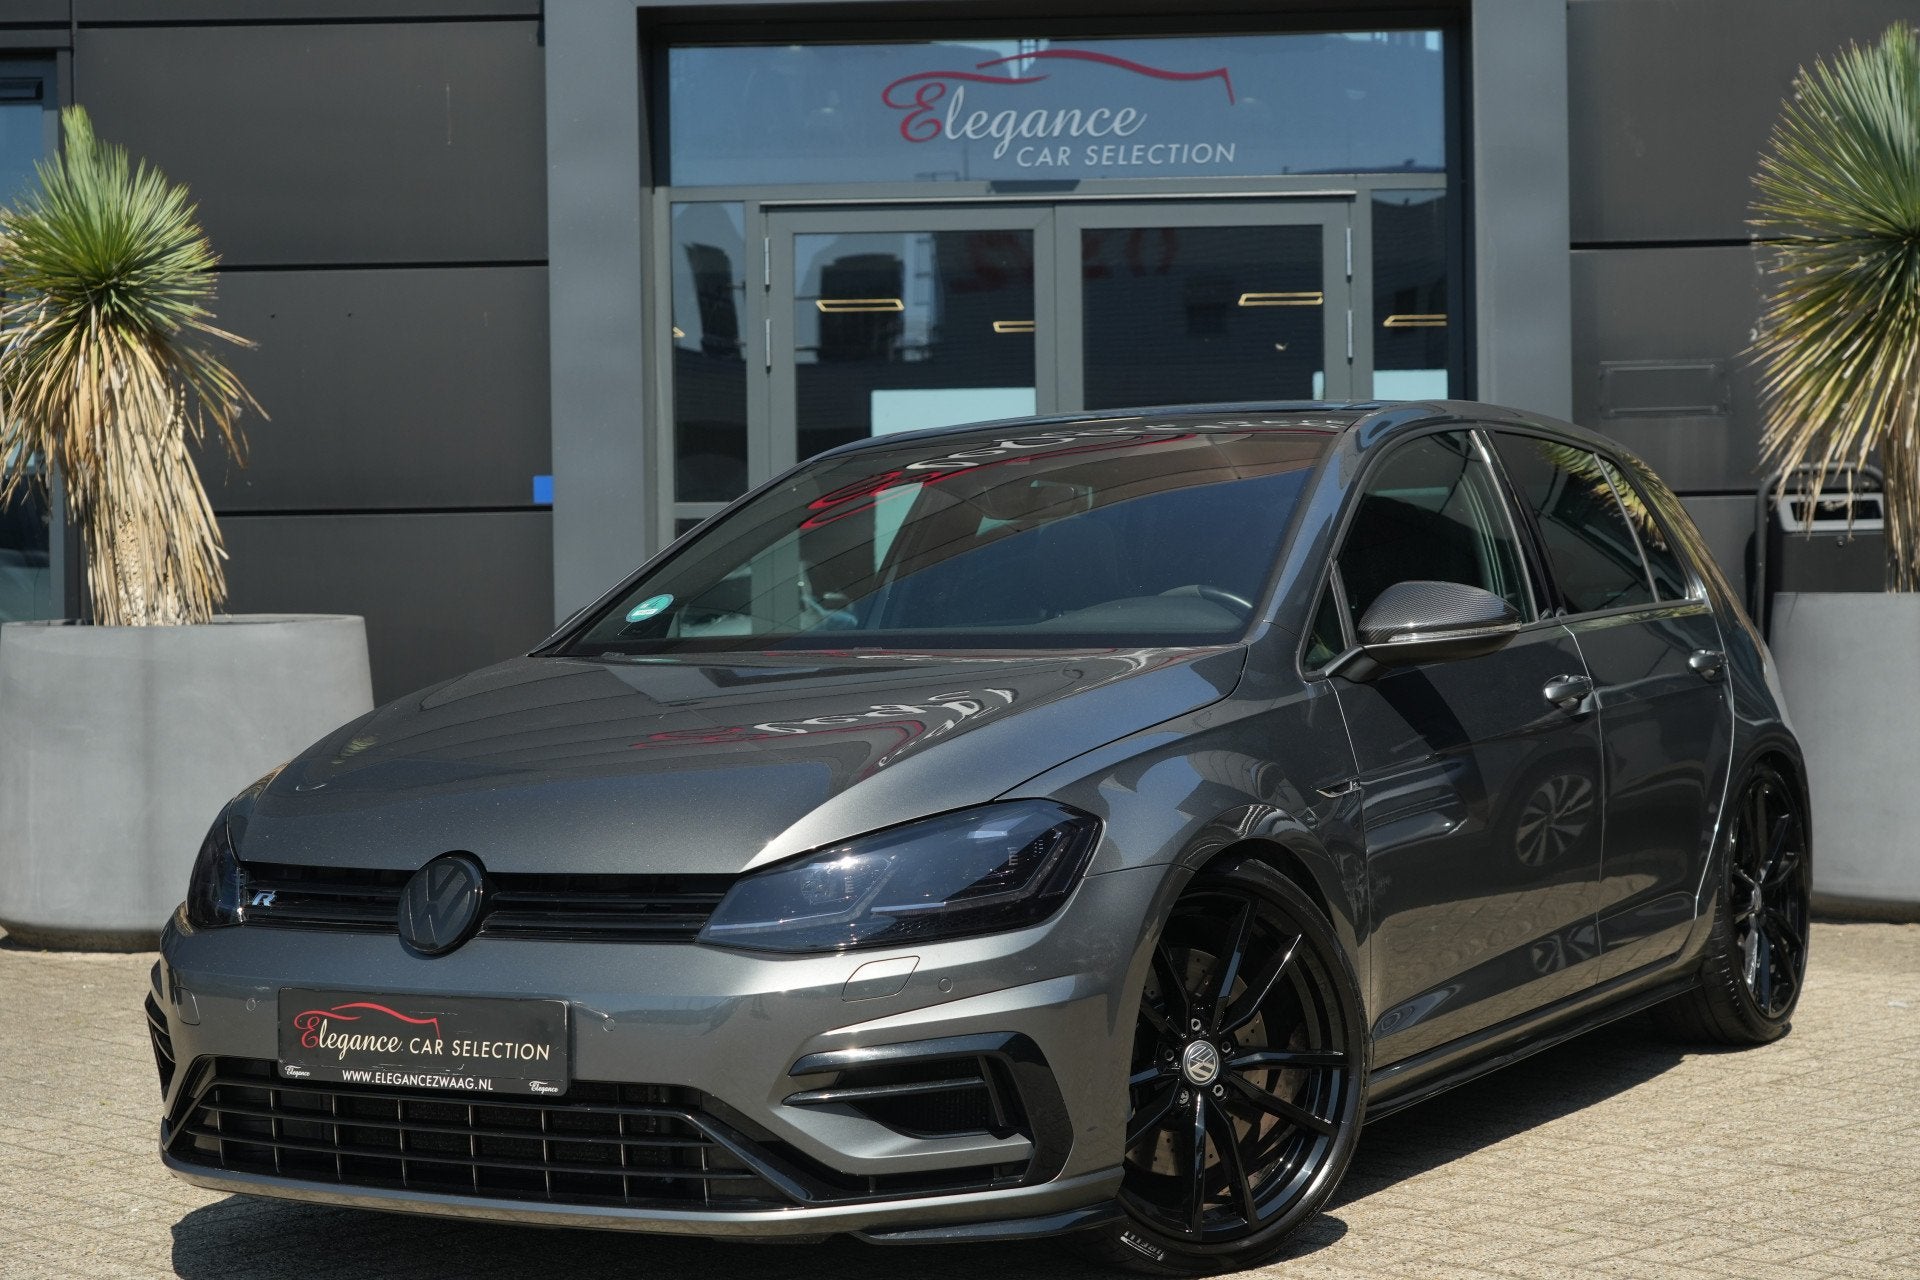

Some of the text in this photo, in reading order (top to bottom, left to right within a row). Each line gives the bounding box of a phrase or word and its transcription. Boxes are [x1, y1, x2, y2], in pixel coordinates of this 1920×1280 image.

[884, 78, 1147, 160] Elegance
[1016, 143, 1235, 167] CAR SELECTION
[251, 888, 277, 907] R
[296, 1012, 550, 1061] Elegance CAR SELECTION
[342, 1068, 494, 1091] WWW.ELEGANCEZWAAG.NL
